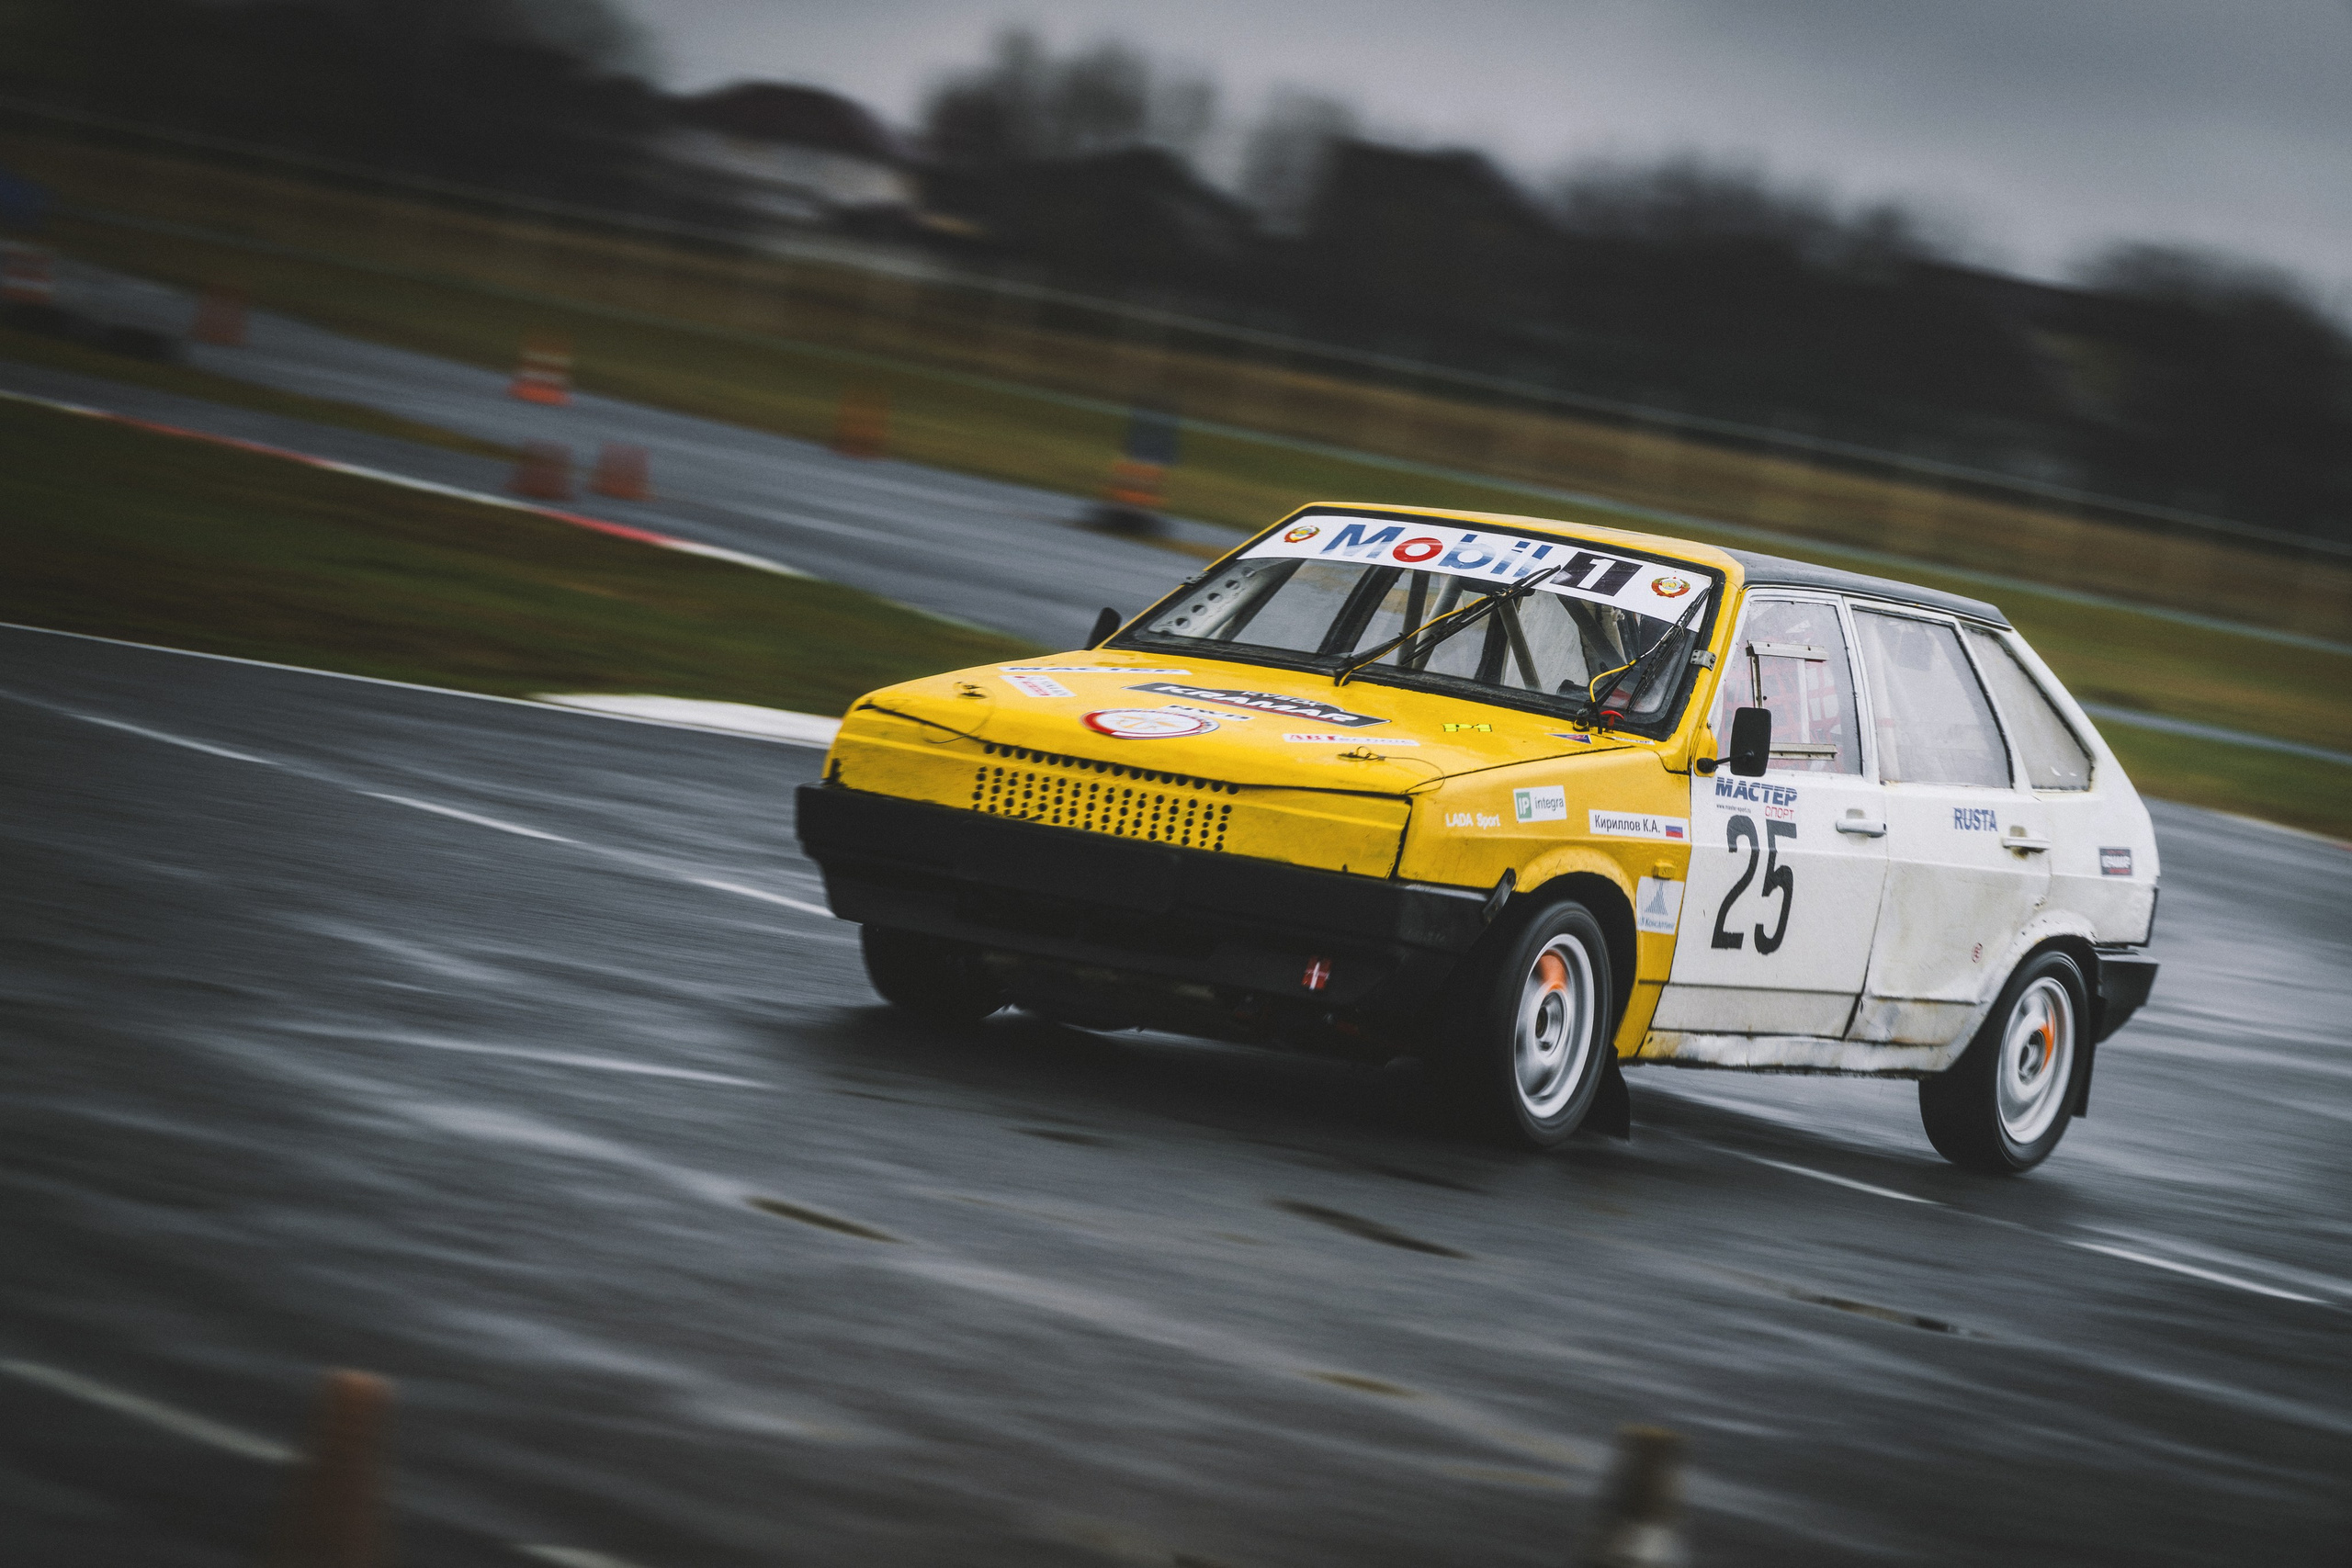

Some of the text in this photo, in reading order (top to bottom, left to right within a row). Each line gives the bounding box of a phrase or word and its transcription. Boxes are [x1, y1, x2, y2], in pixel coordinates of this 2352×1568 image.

[1321, 523, 1554, 578] Mobil
[1154, 685, 1359, 722] KRAMAR
[1534, 796, 1564, 811] integra
[1715, 776, 1797, 806] МАСТЕР
[1445, 812, 1500, 829] LADA Sport
[1594, 814, 1661, 833] Кириллов К.А.
[1764, 806, 1794, 820] СПОРТ
[1953, 807, 1997, 832] RUSTA
[1711, 814, 1797, 955] 25
